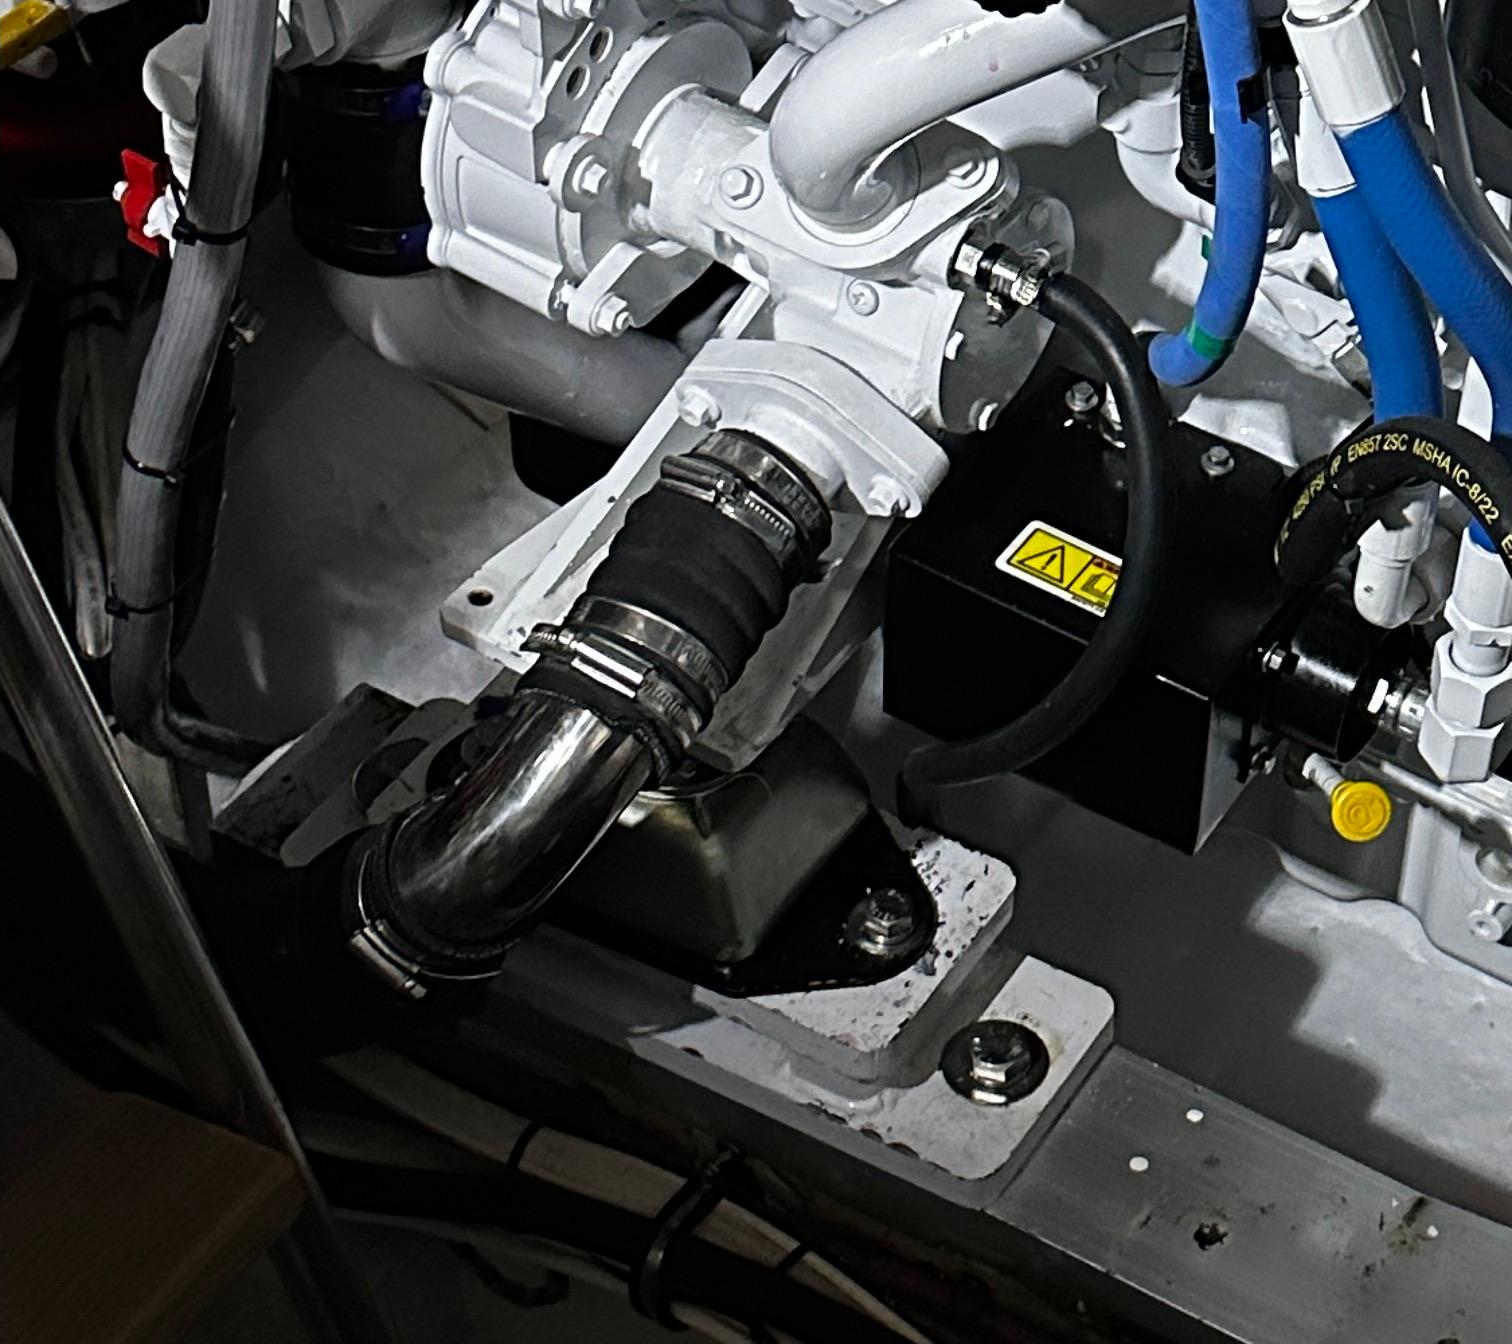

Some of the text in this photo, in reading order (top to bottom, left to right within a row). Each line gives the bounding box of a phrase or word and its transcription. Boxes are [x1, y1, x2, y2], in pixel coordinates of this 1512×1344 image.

[1382, 432, 1409, 452] 2SC
[1412, 437, 1453, 474] MSHA
[1451, 463, 1500, 526] IC-8/22
